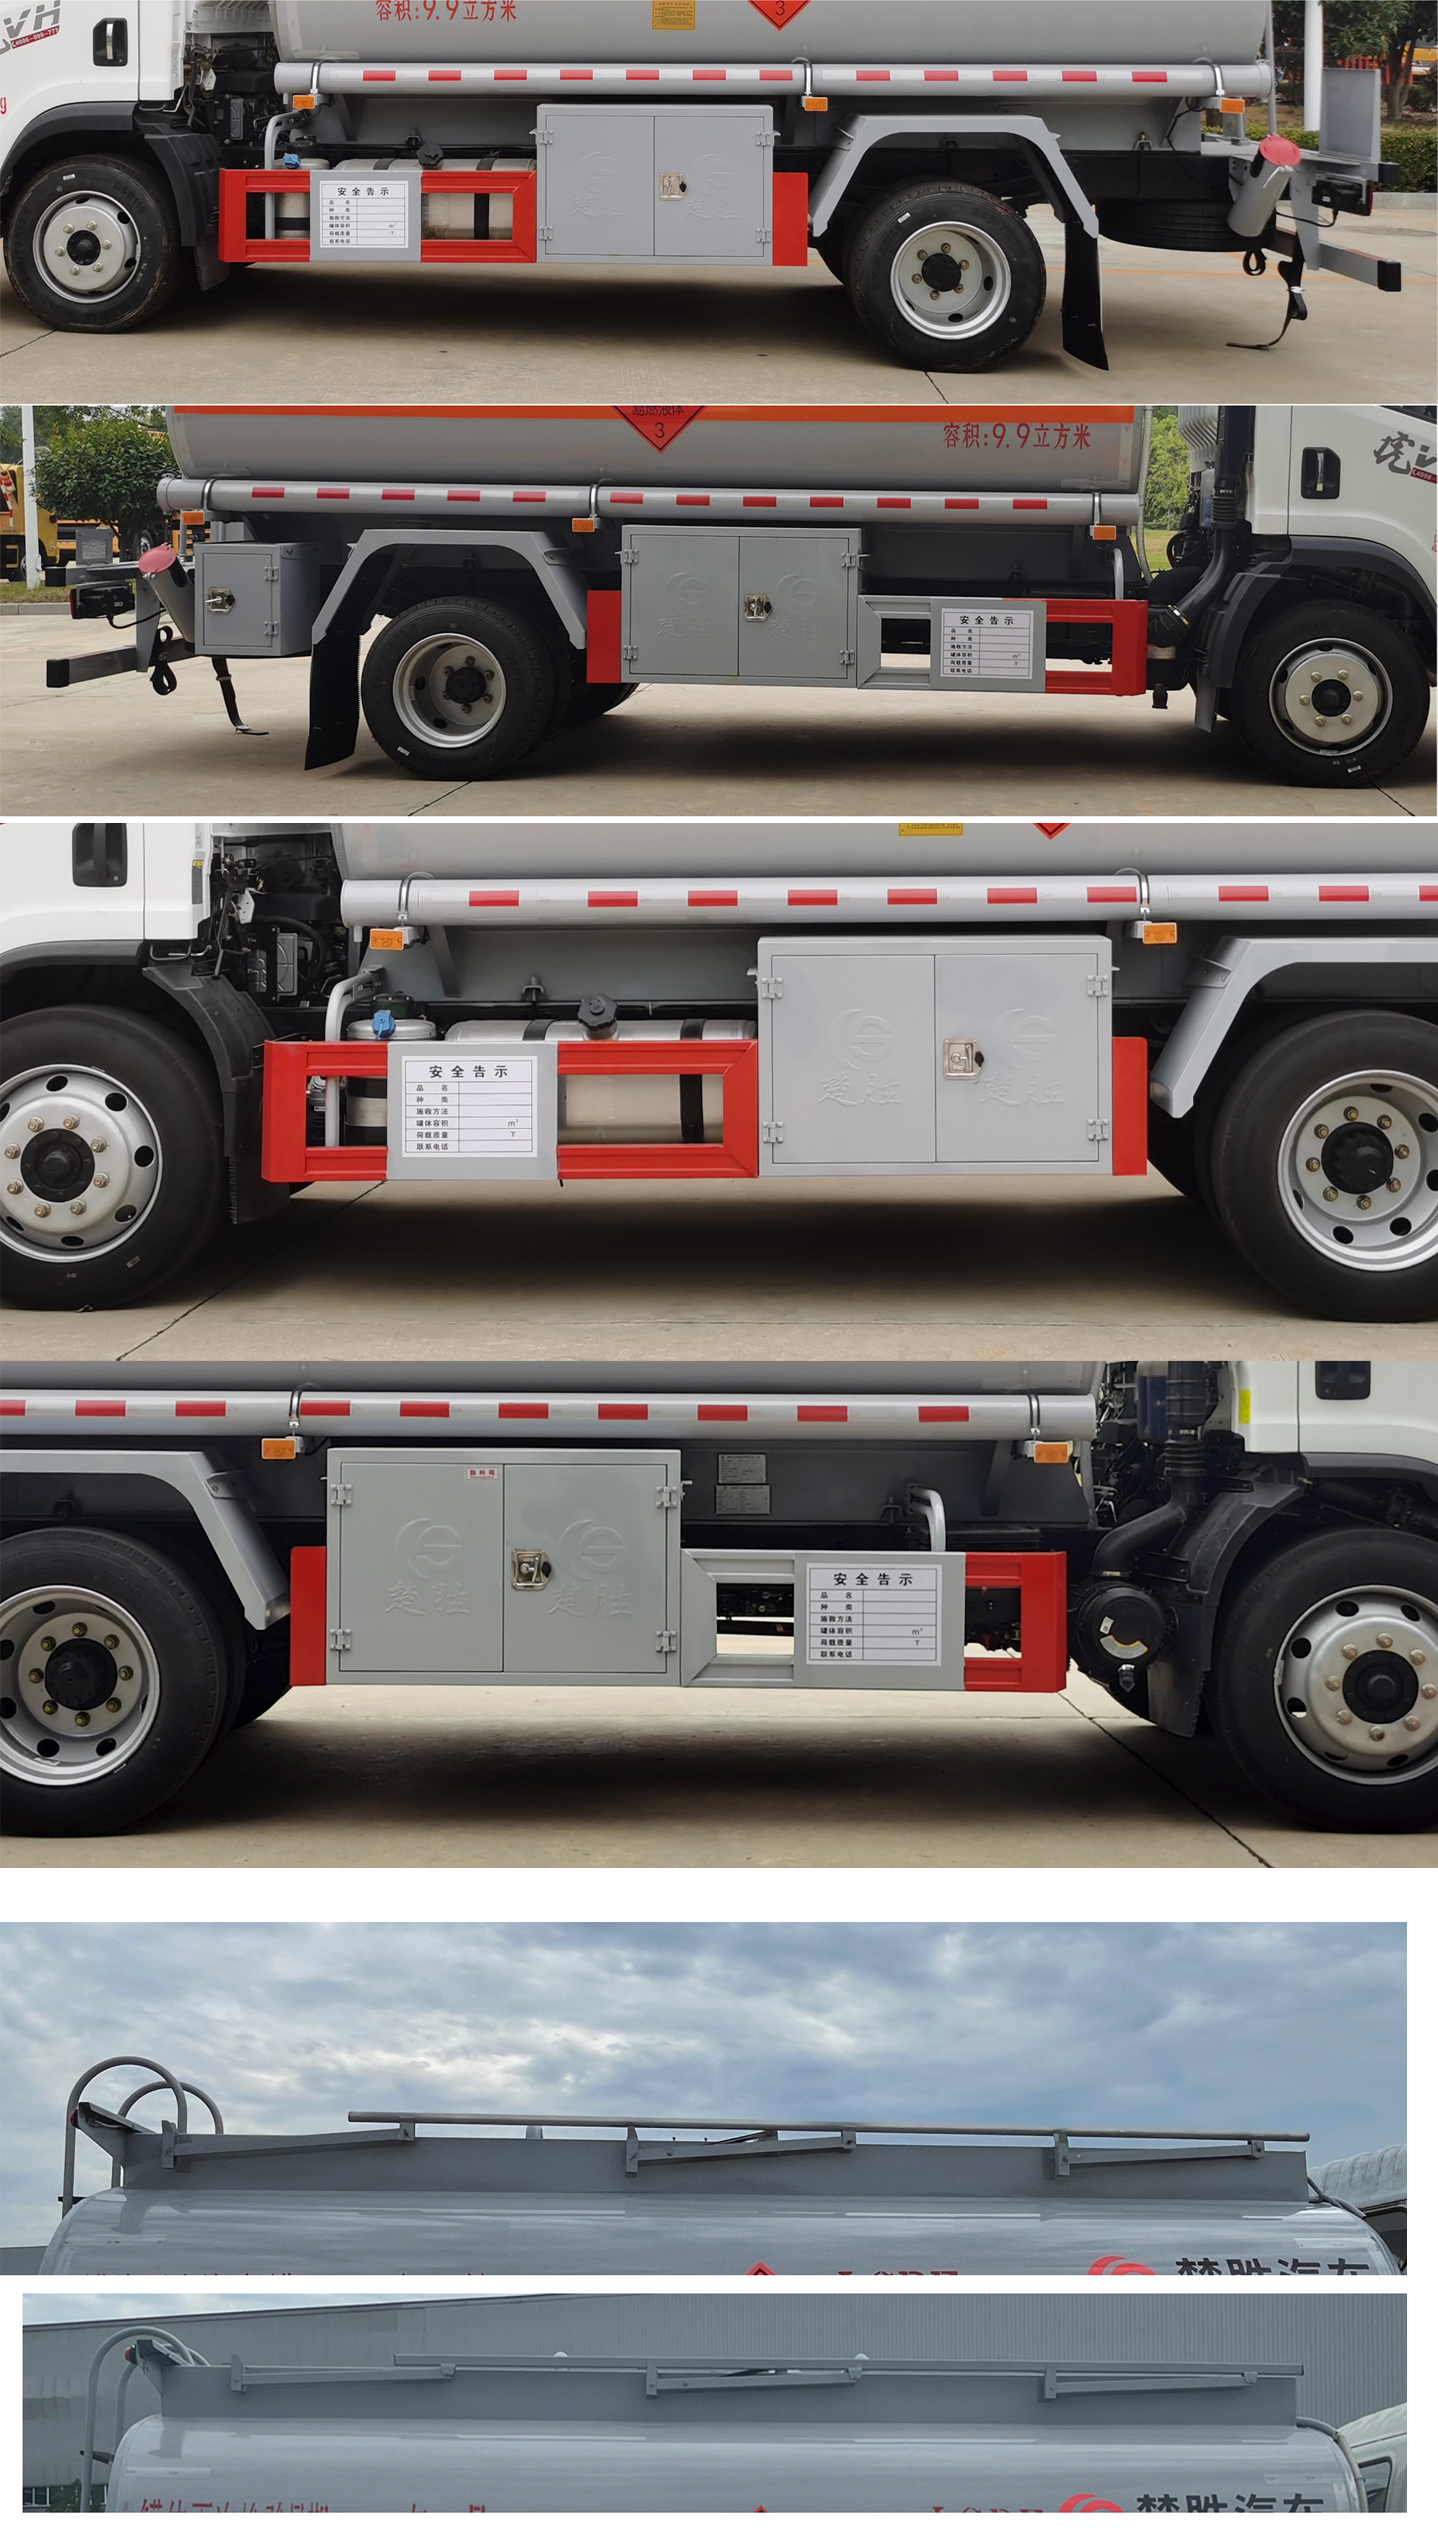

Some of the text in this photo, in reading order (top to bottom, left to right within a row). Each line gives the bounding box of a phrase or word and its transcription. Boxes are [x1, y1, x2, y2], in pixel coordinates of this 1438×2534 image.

[775, 0, 785, 16] 3
[337, 187, 389, 196] 安全告示
[655, 422, 665, 438] 3
[960, 615, 1014, 625] 安全告示
[429, 1065, 508, 1078] 安全告示
[833, 1572, 913, 1586] 安全告示
